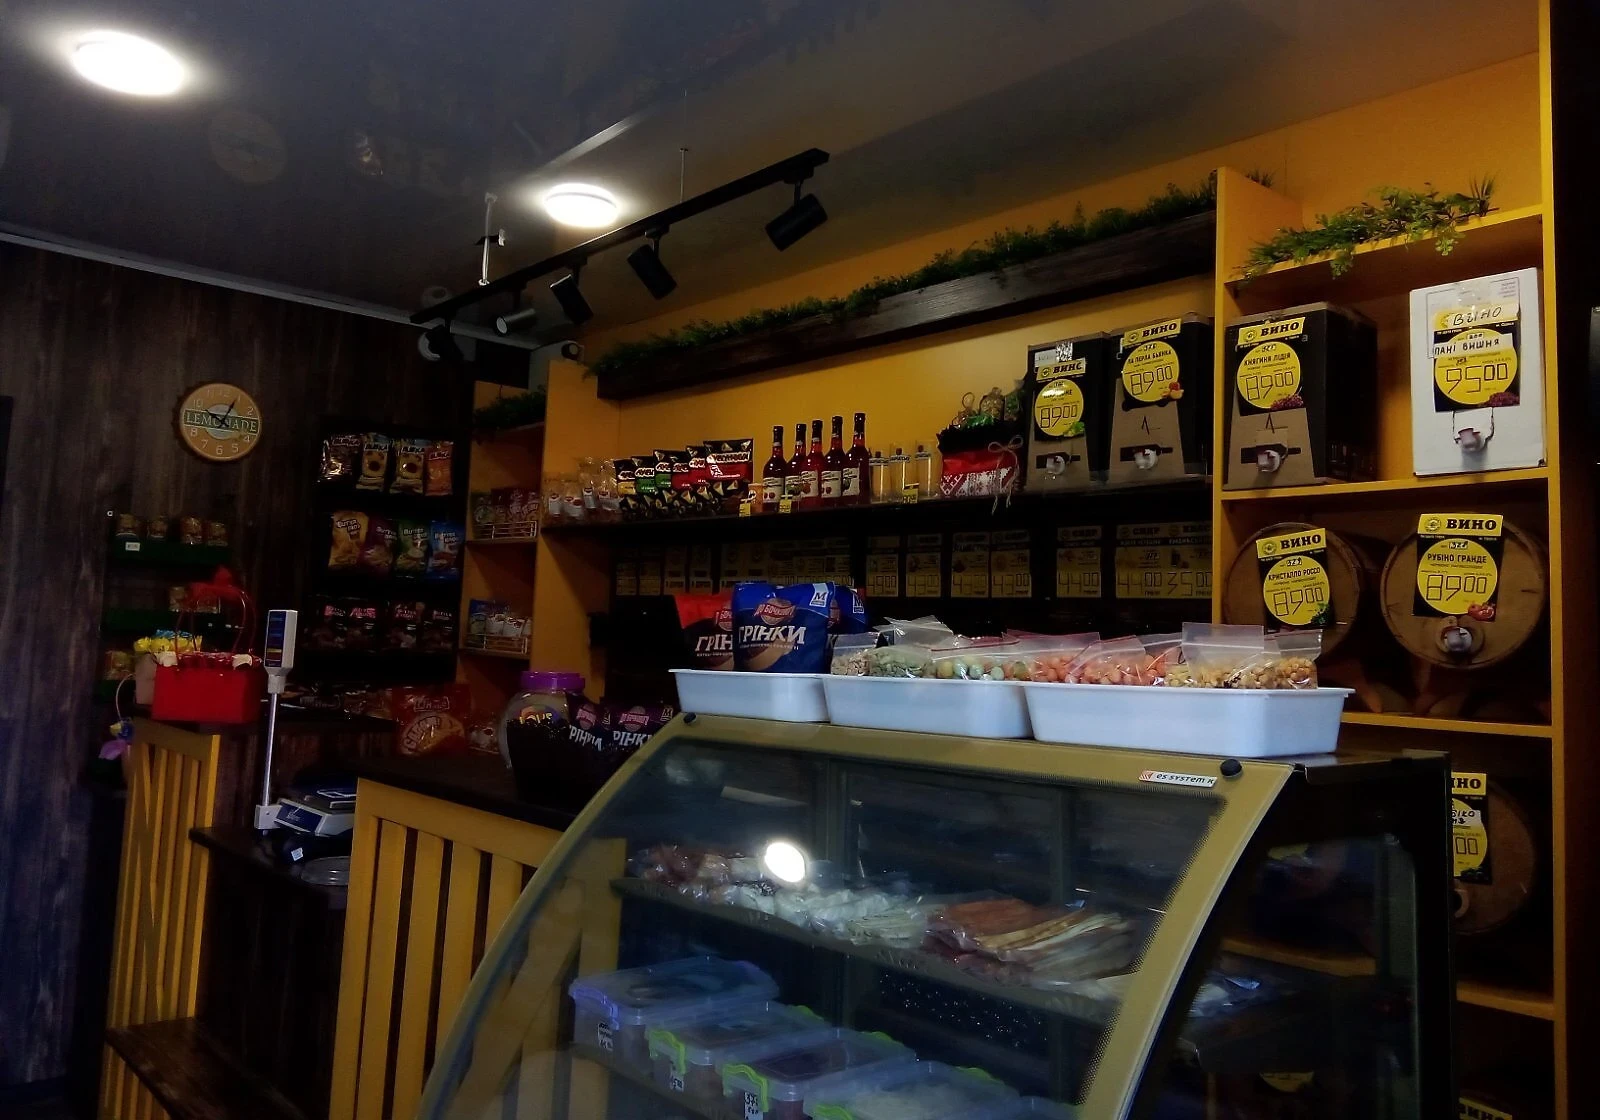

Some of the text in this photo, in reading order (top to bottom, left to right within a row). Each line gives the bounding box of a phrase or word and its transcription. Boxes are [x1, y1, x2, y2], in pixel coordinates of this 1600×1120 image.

[1142, 322, 1177, 338] ВИНО
[1261, 321, 1300, 337] ВИНО
[1434, 338, 1500, 356] ПАНІ ВИШНЯ
[1243, 355, 1272, 366] КНЯГИНЯ
[216, 445, 223, 455] 6
[1446, 518, 1497, 531] ВИНО
[1281, 534, 1322, 549] ВИНО
[1427, 553, 1487, 564] РУБІНО ГРАНДЕ
[1268, 566, 1321, 581] КРИСТАЛЛО РОССО
[738, 625, 807, 645] ГРІНКИ
[569, 725, 603, 751] РІНКИ
[612, 730, 653, 747] РІНК
